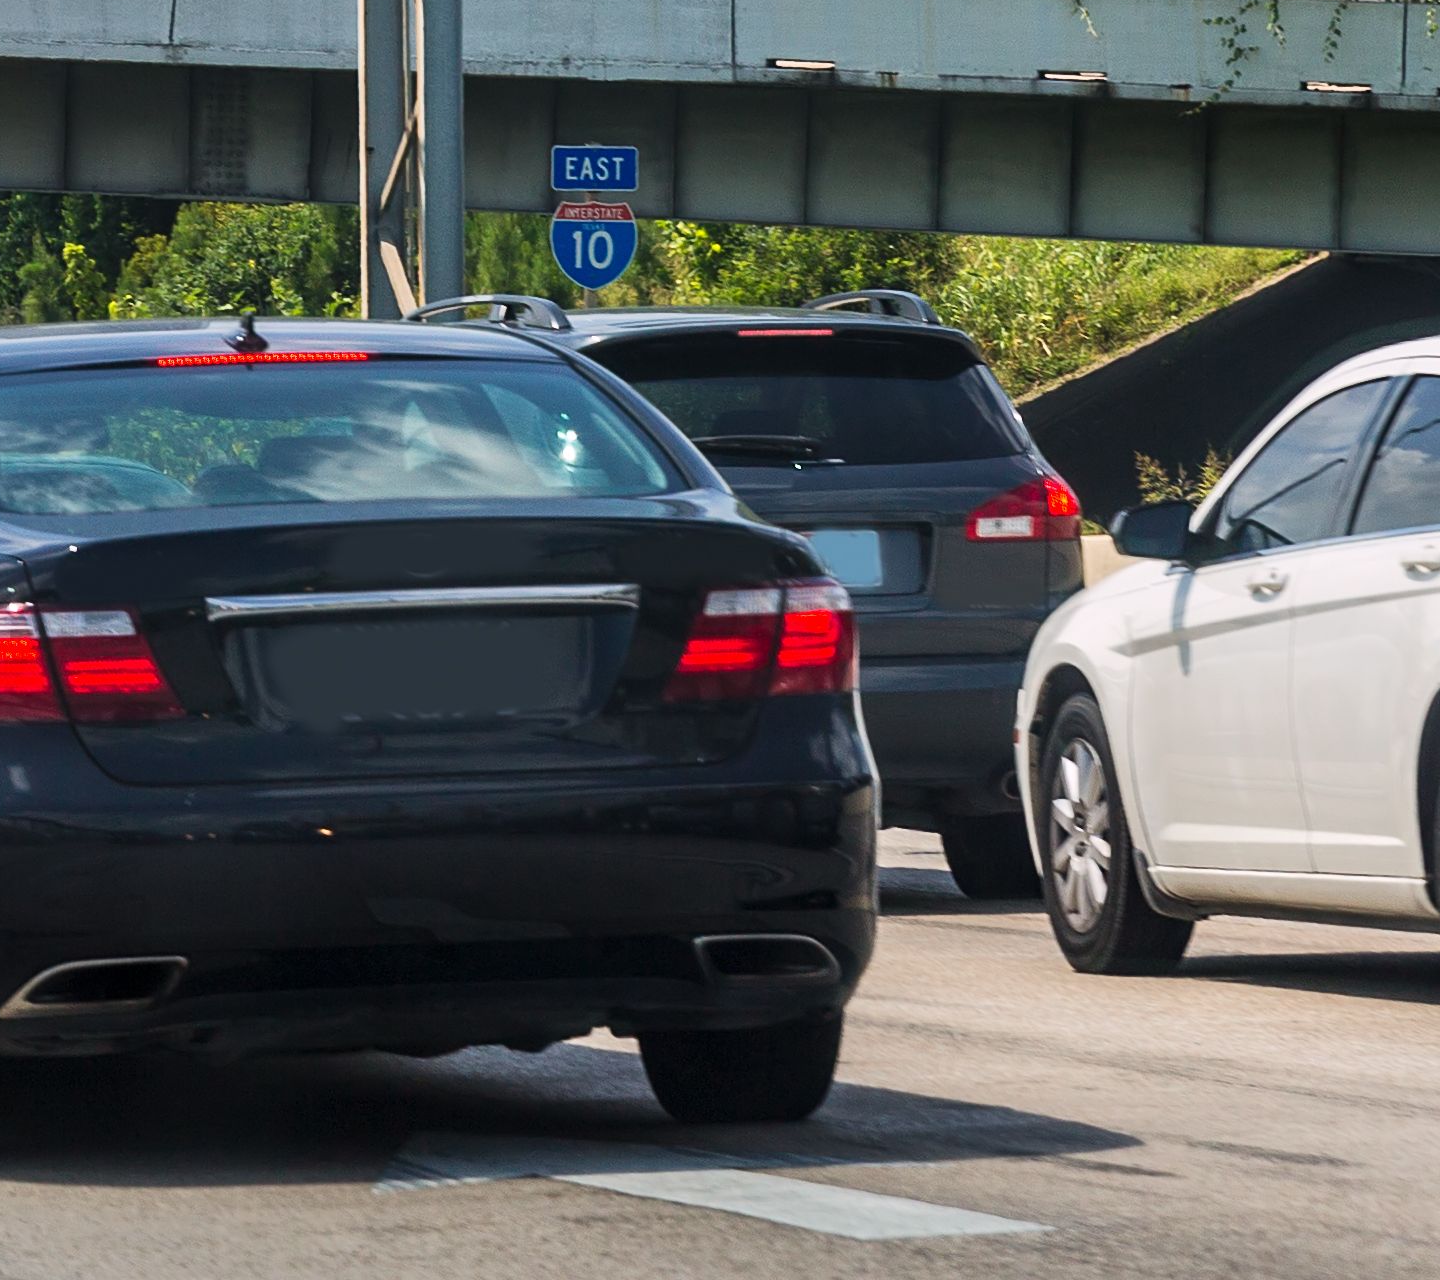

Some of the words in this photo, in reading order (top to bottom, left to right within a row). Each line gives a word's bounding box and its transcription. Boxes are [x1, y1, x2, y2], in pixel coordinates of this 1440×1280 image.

[565, 156, 625, 181] EAST
[564, 208, 624, 219] INTERSTATE
[573, 230, 614, 270] 10
